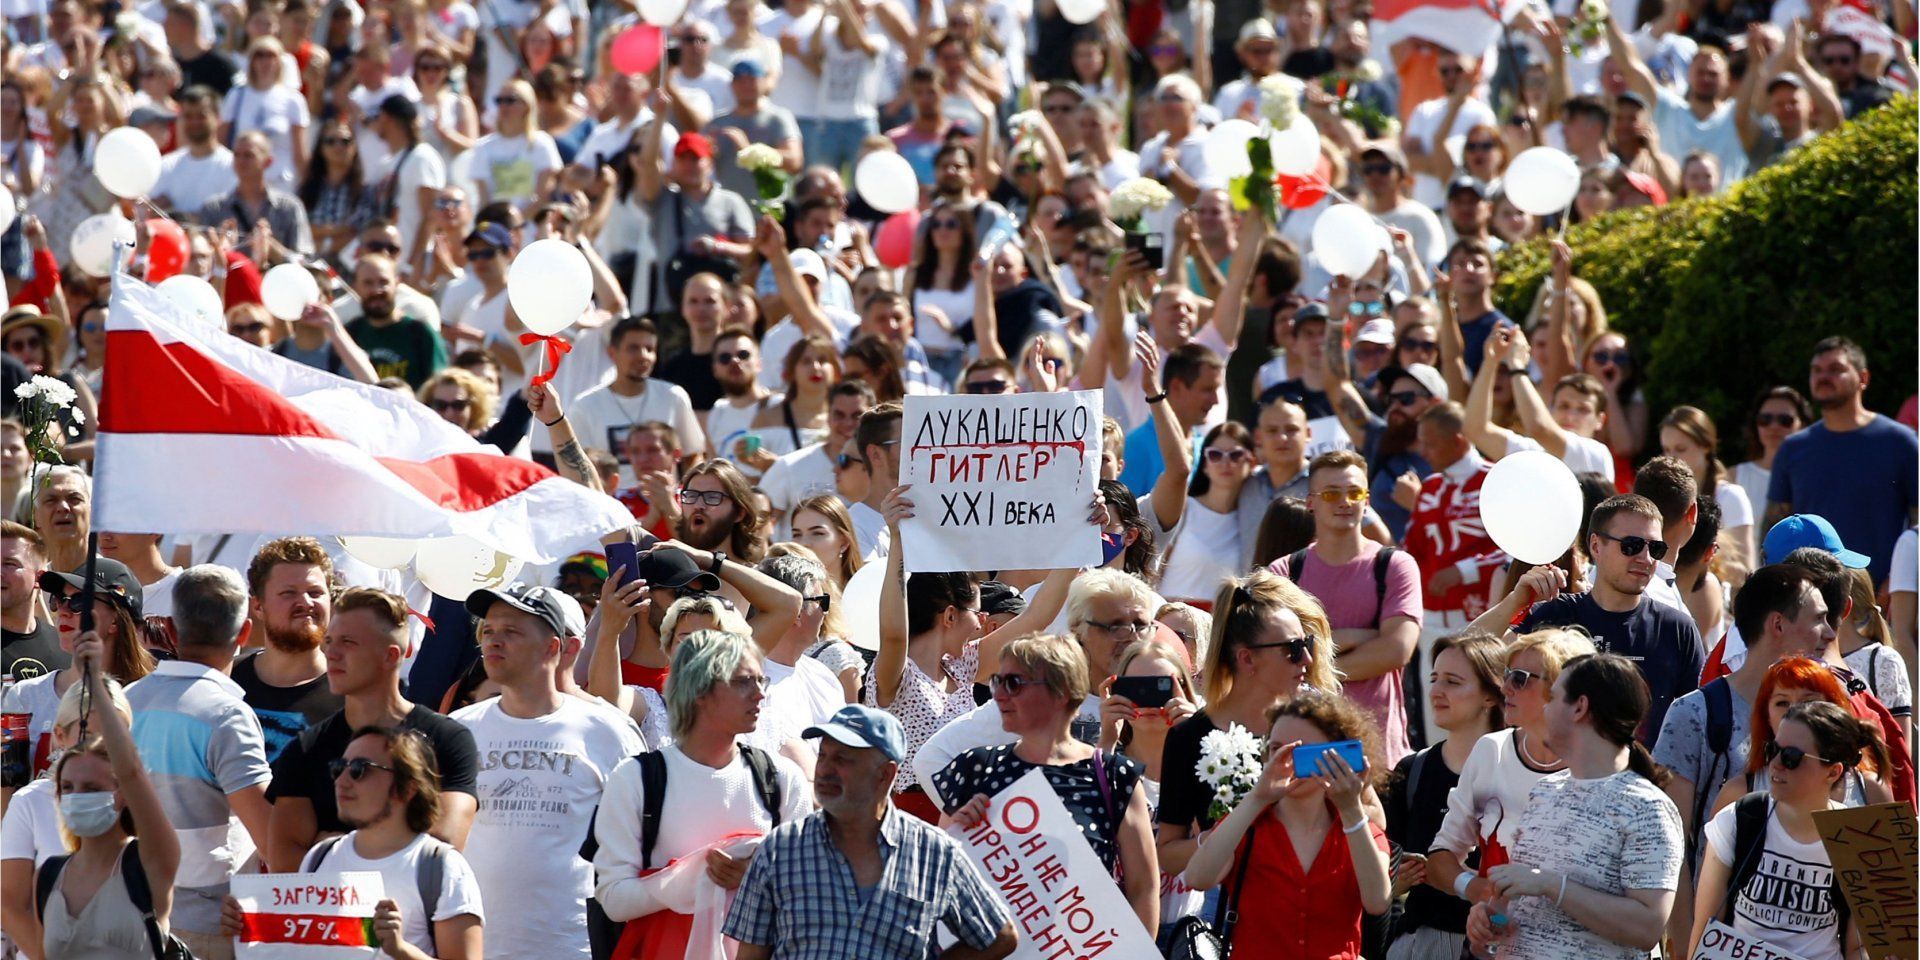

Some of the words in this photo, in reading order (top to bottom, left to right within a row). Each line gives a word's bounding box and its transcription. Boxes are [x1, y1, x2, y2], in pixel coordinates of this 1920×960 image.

[915, 405, 1087, 447] ЛУКАШЕНКО
[929, 450, 1050, 483] ГИТЛЕР
[940, 491, 994, 526] XXI
[1004, 499, 1055, 526] ВЕКА
[493, 799, 538, 811] DRAMATIC
[540, 800, 569, 814] PEAKS
[963, 819, 1086, 960] ПРЕЗИДЕНТ
[1002, 796, 1047, 857] ОН
[1033, 854, 1068, 892] НЕ
[1055, 885, 1119, 958] МОЙ
[1743, 874, 1833, 913] DVISOR
[1739, 898, 1784, 924] EXPLICIT
[1841, 869, 1892, 947] ВЛАСТИ
